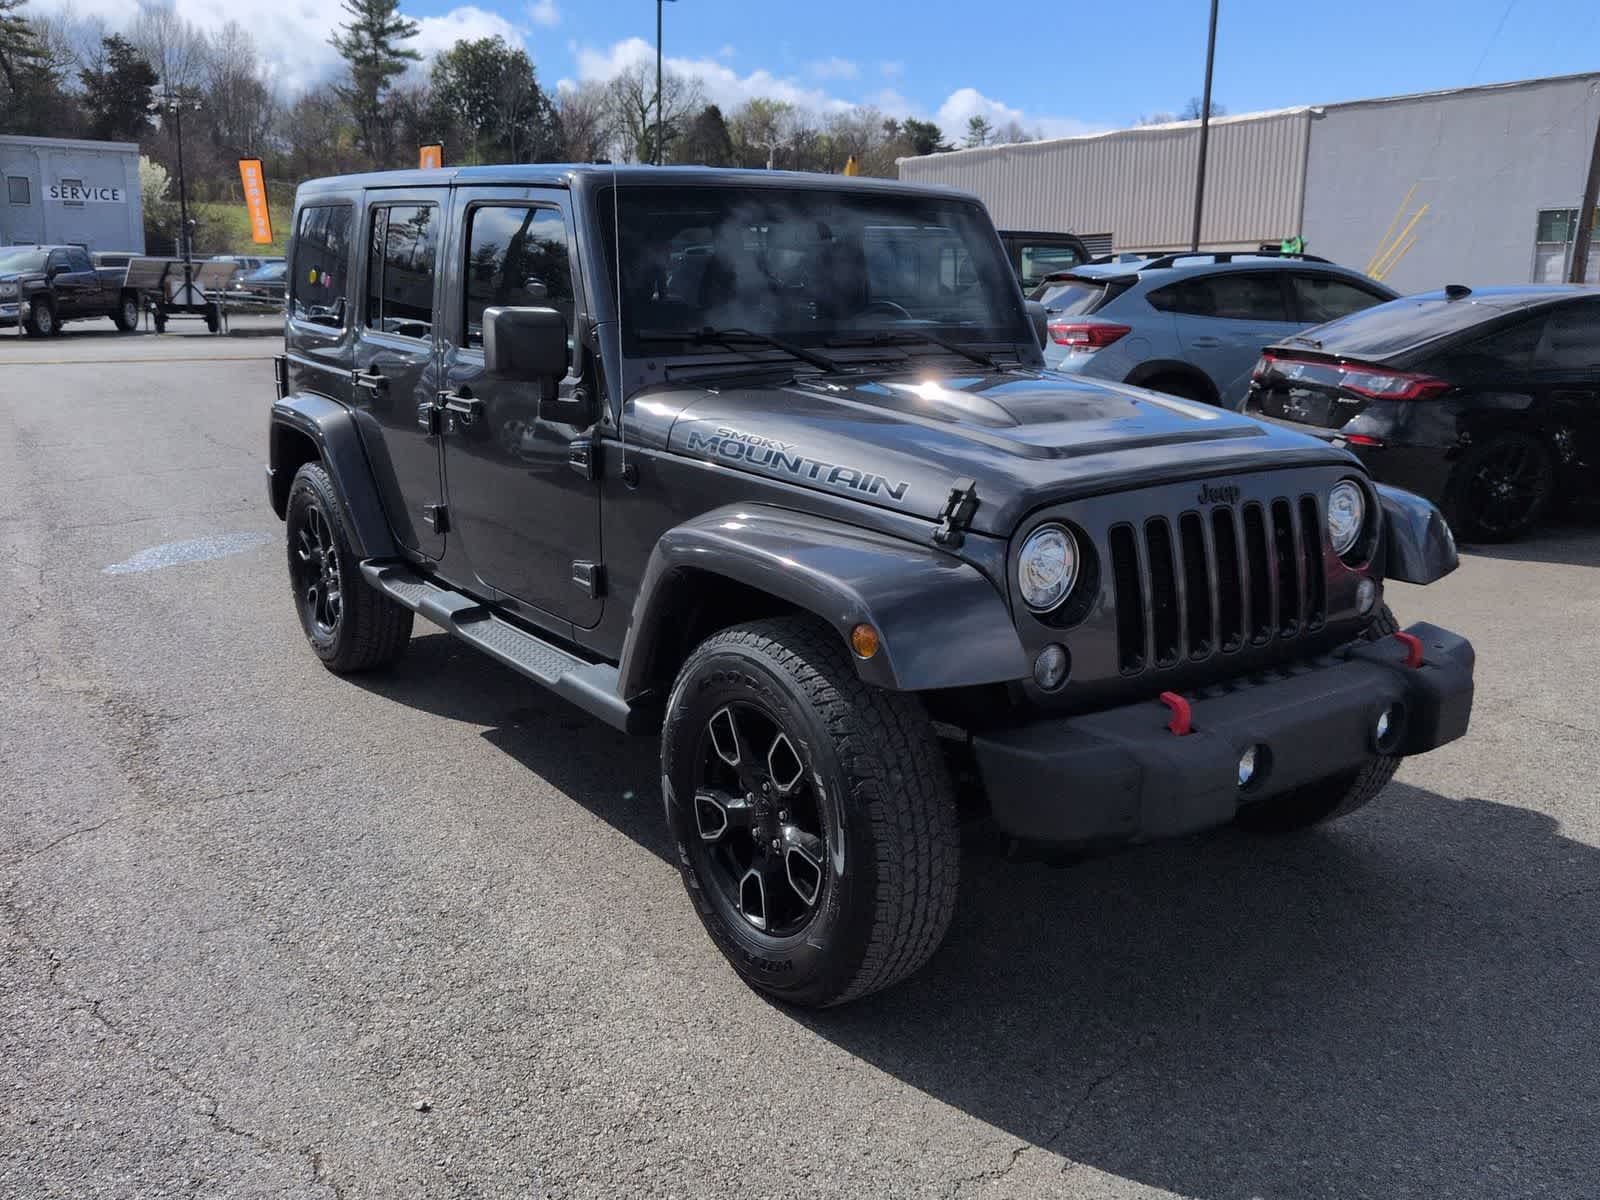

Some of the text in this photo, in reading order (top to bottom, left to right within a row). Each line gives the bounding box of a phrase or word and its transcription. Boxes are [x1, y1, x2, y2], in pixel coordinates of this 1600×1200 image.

[50, 185, 120, 201] SERVICE
[716, 427, 796, 451] SMOKY
[686, 430, 910, 503] MOUNTAIN
[1197, 482, 1240, 505] Jeep
